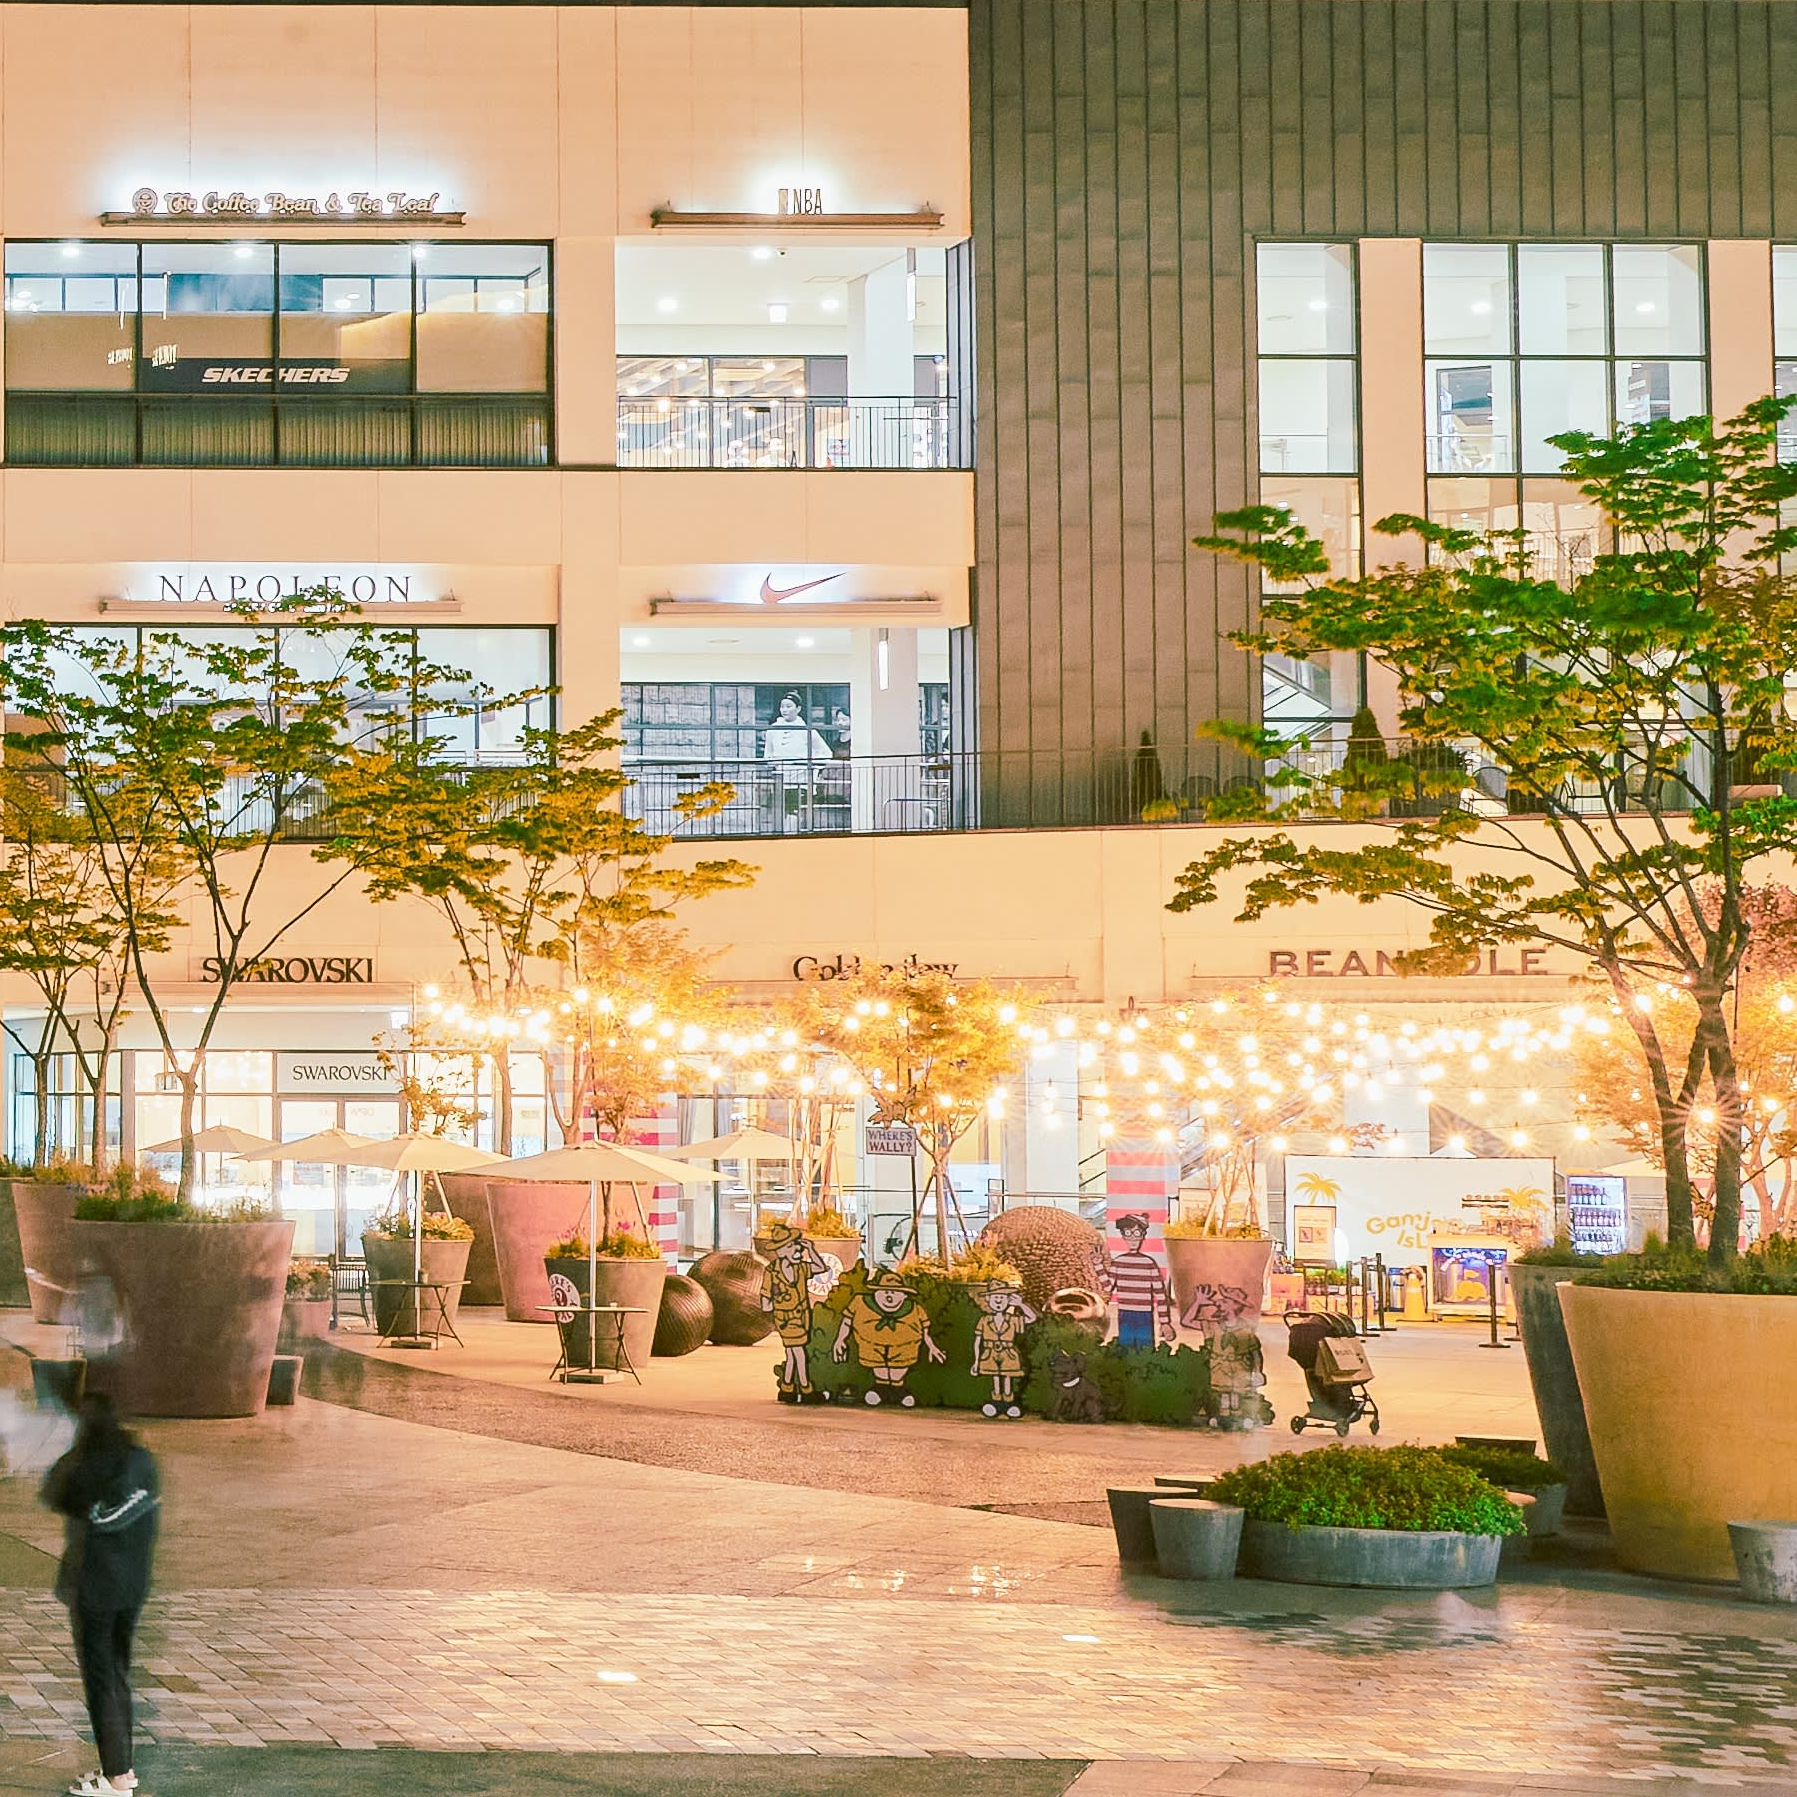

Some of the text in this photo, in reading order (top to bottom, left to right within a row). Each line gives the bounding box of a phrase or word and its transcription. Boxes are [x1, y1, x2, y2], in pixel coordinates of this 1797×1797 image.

[164, 192, 439, 215] The Coffee Bean & Tea Leaf
[793, 188, 823, 216] NBA
[202, 367, 351, 383] SKECHERS
[292, 1065, 389, 1081] SWAROVSKI
[868, 1130, 913, 1141] WHERE'S
[869, 1141, 912, 1152] WALLY?
